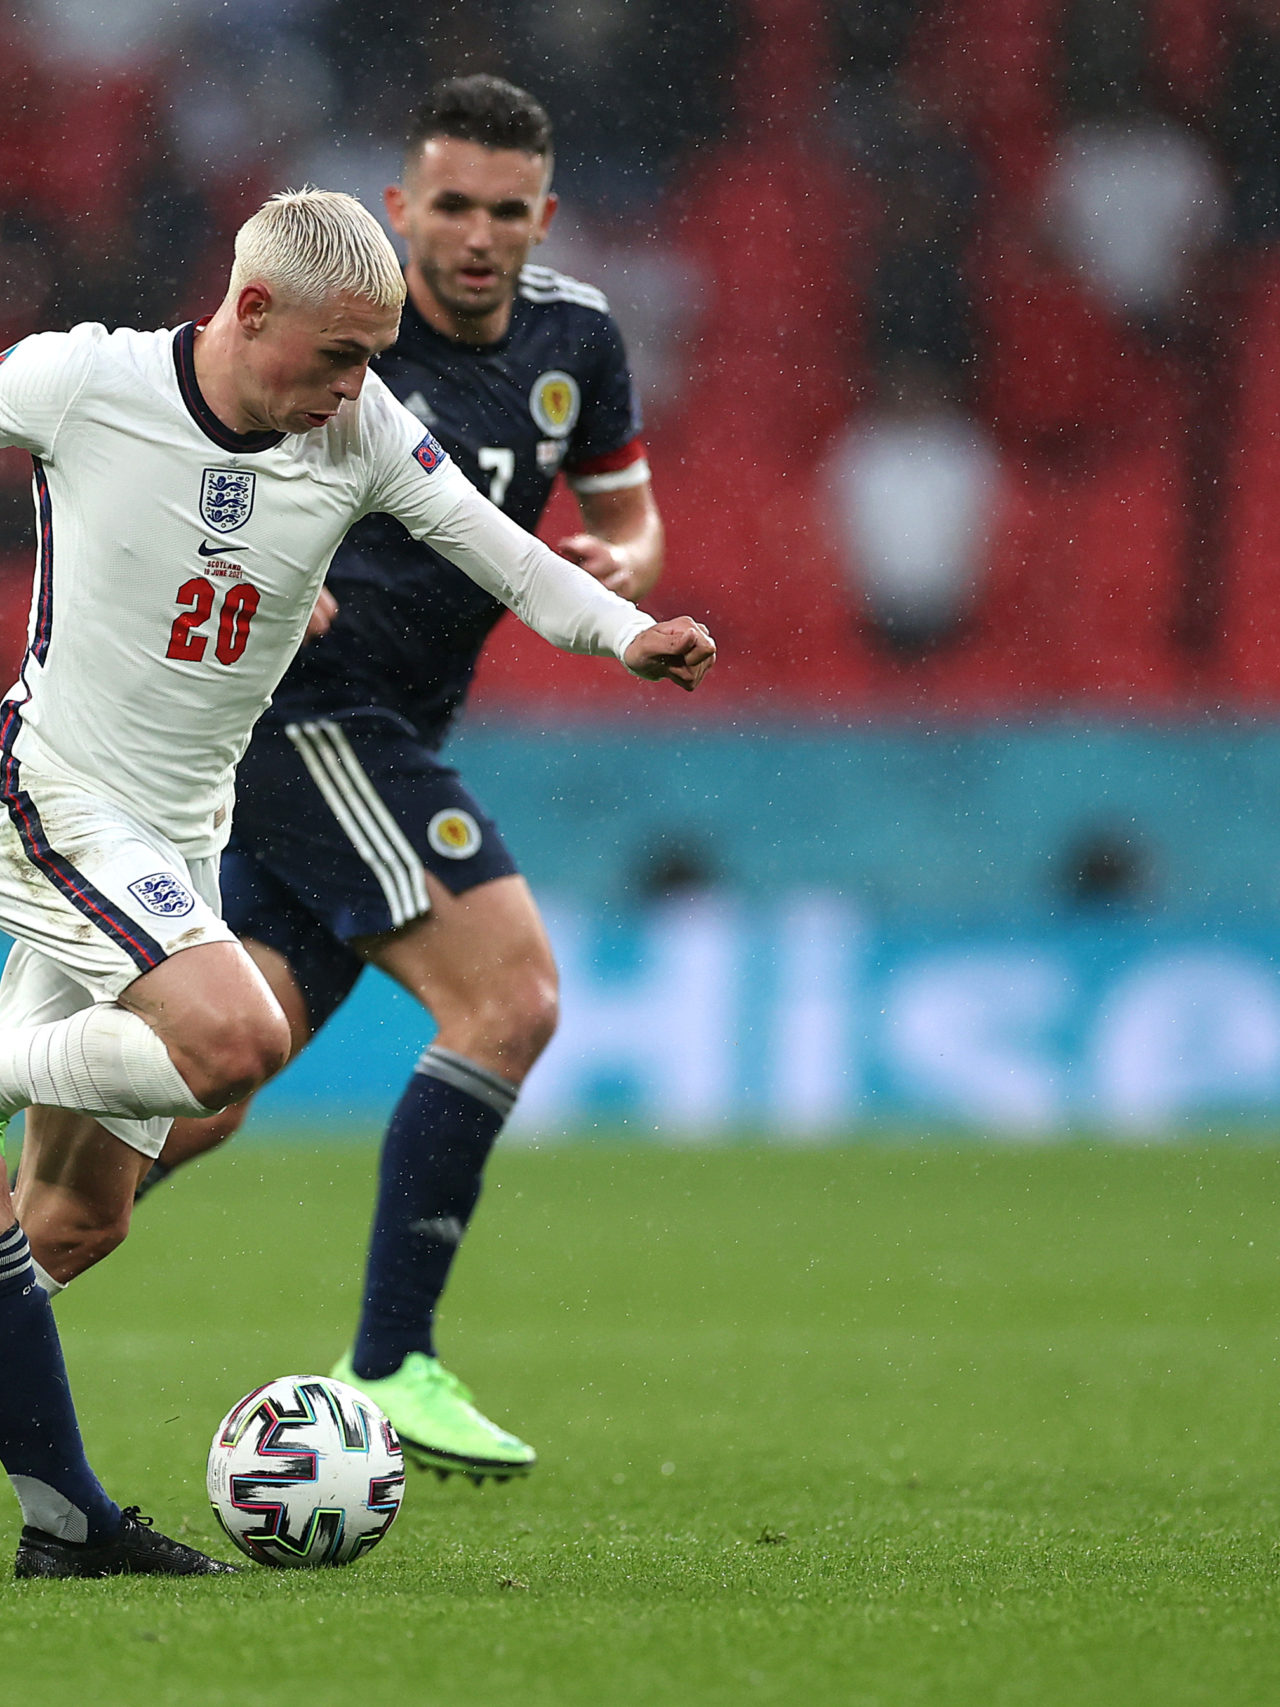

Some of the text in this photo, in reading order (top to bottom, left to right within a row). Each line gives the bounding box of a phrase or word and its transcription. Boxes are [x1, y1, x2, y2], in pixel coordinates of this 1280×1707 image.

[478, 447, 515, 506] 7
[207, 560, 242, 571] SCOTLAND
[211, 569, 228, 577] JUNE
[228, 570, 243, 579] 2021
[166, 576, 261, 666] 20
